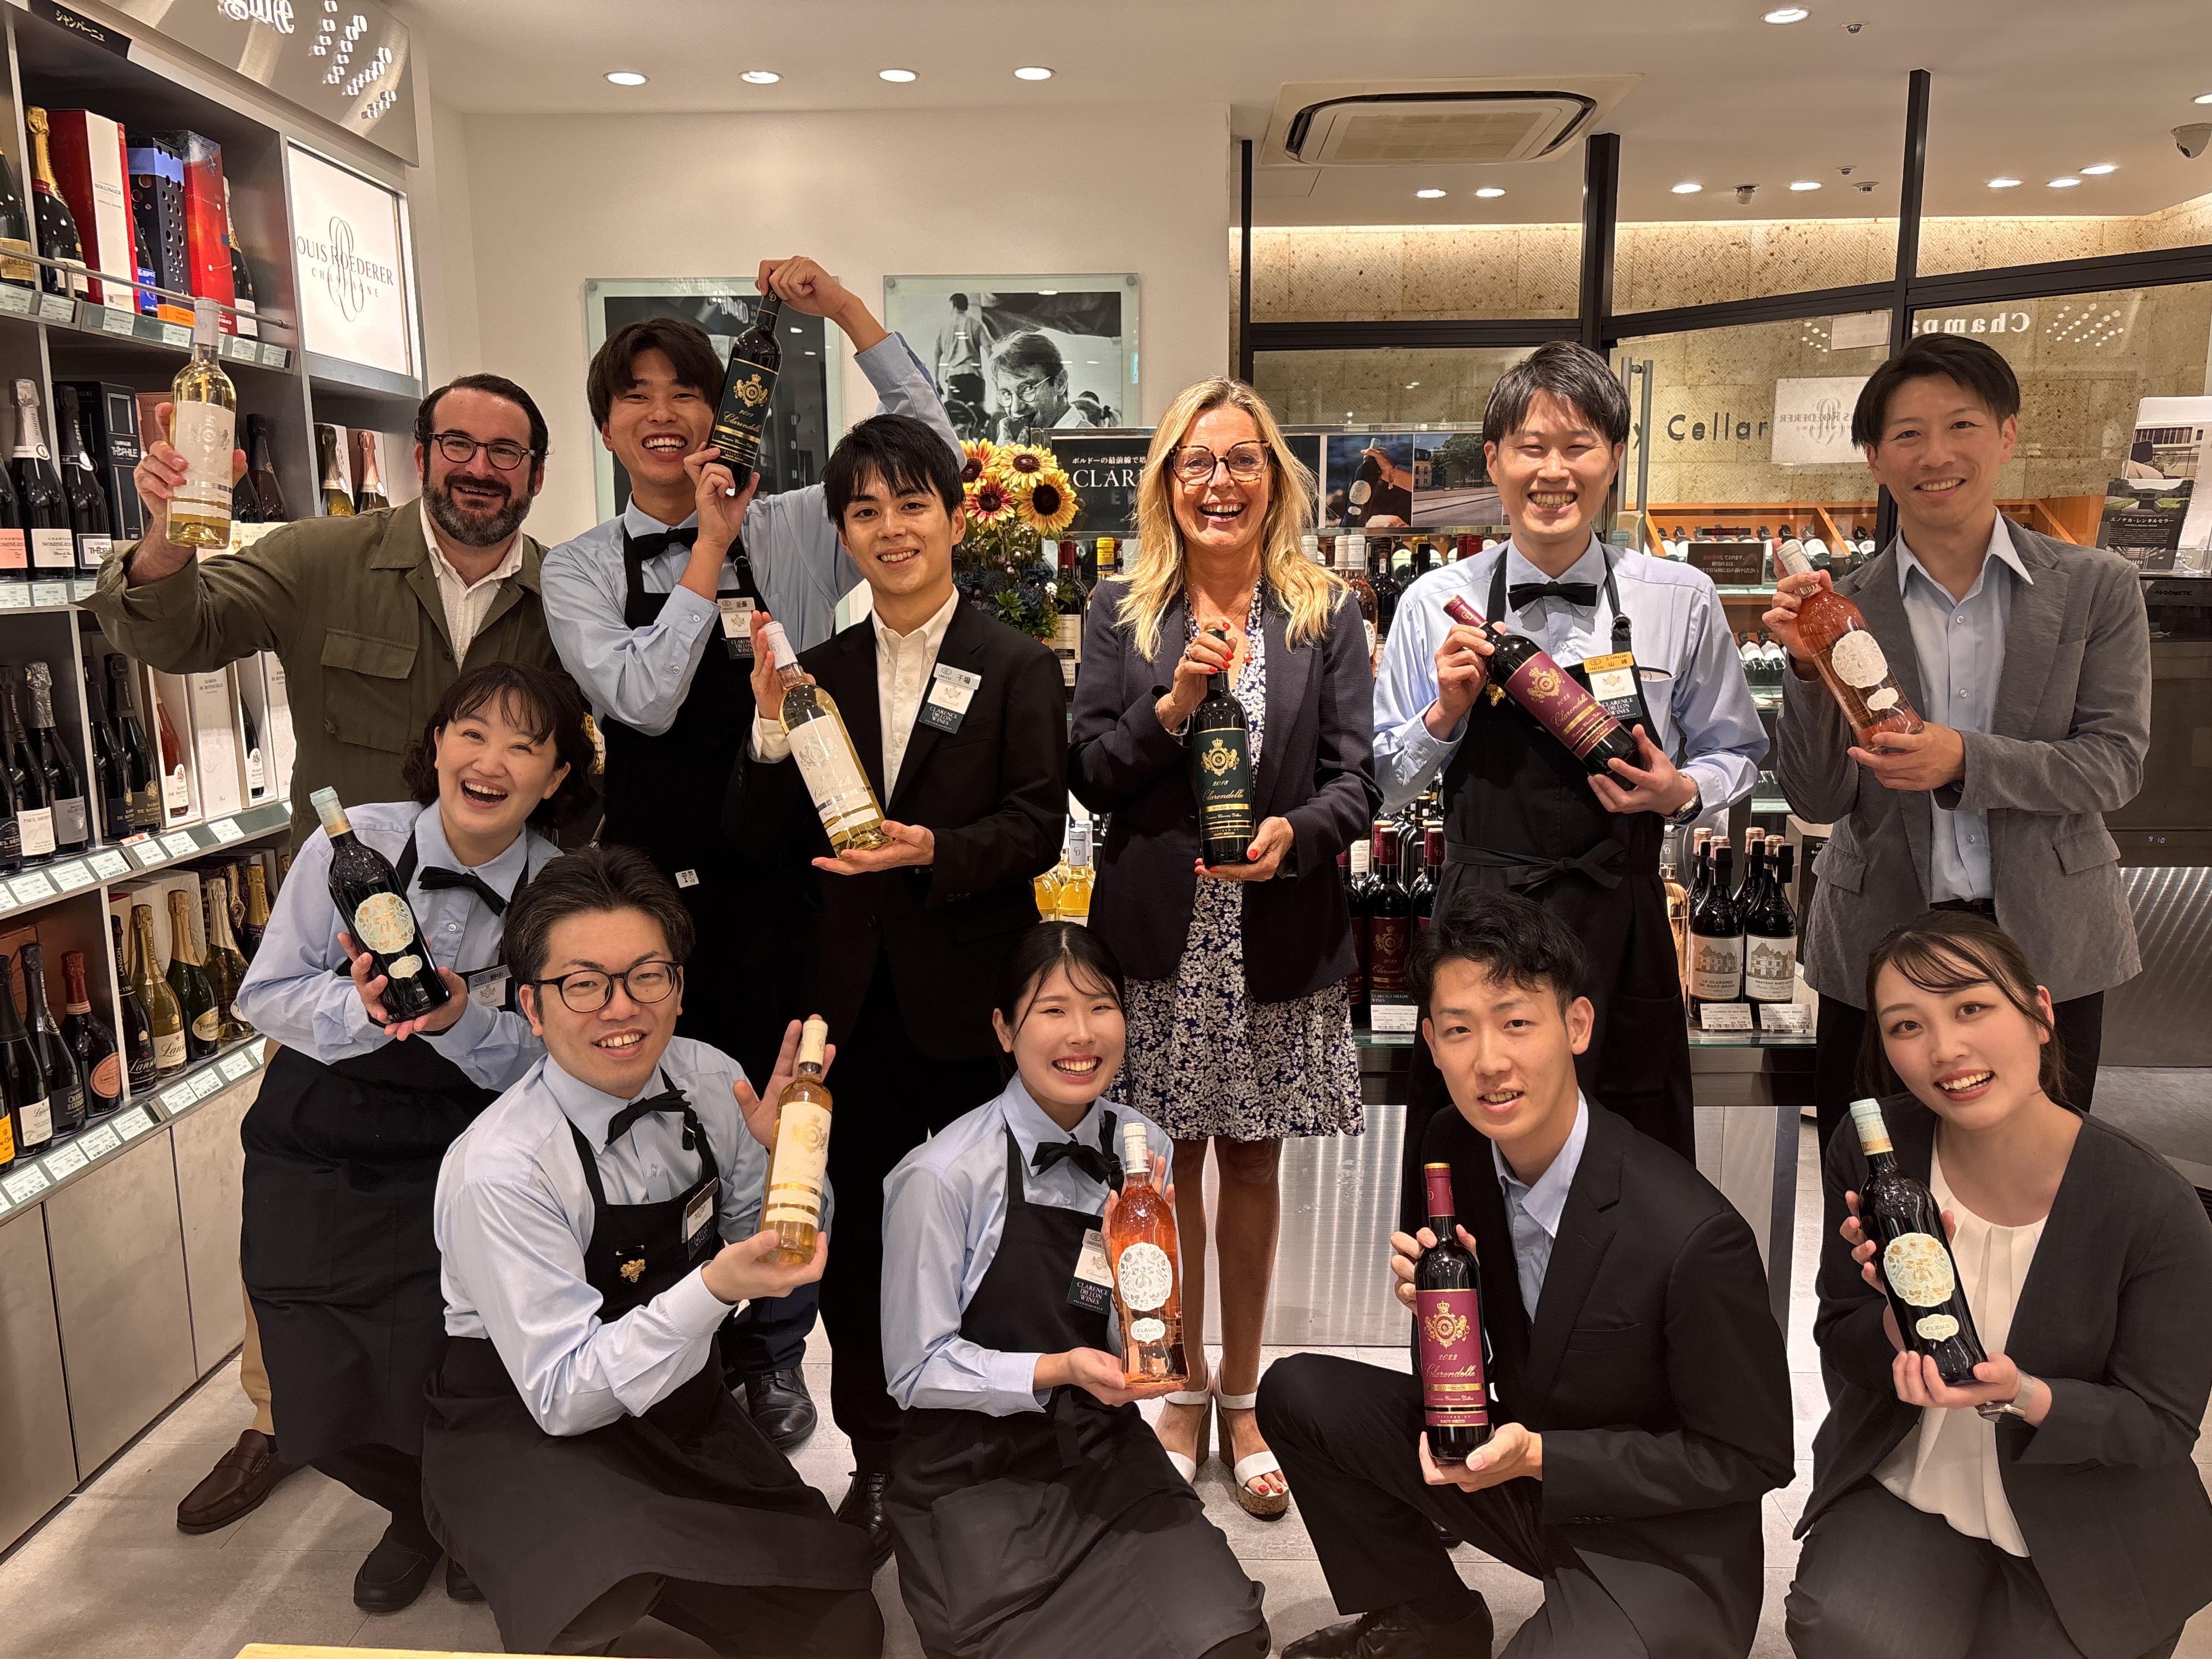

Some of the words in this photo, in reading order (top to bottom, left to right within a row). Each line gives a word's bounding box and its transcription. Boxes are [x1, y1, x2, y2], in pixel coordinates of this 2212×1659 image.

[297, 236, 328, 262] OUIS
[331, 245, 393, 286] ROEDERER
[1667, 412, 1768, 441] Cellar
[1602, 697, 1634, 707] CLARENCE
[1607, 702, 1630, 712] DILLON
[929, 706, 958, 720] CLARENCE
[932, 712, 952, 722] DILLON
[933, 716, 949, 726] WINES
[1203, 789, 1244, 801] Clarendelle
[116, 947, 125, 977] LANSON
[1077, 1282, 1109, 1296] CLARENCE
[1080, 1288, 1103, 1300] DILLON
[1081, 1294, 1100, 1305] WINES
[1426, 1364, 1477, 1378] Clarendelle
